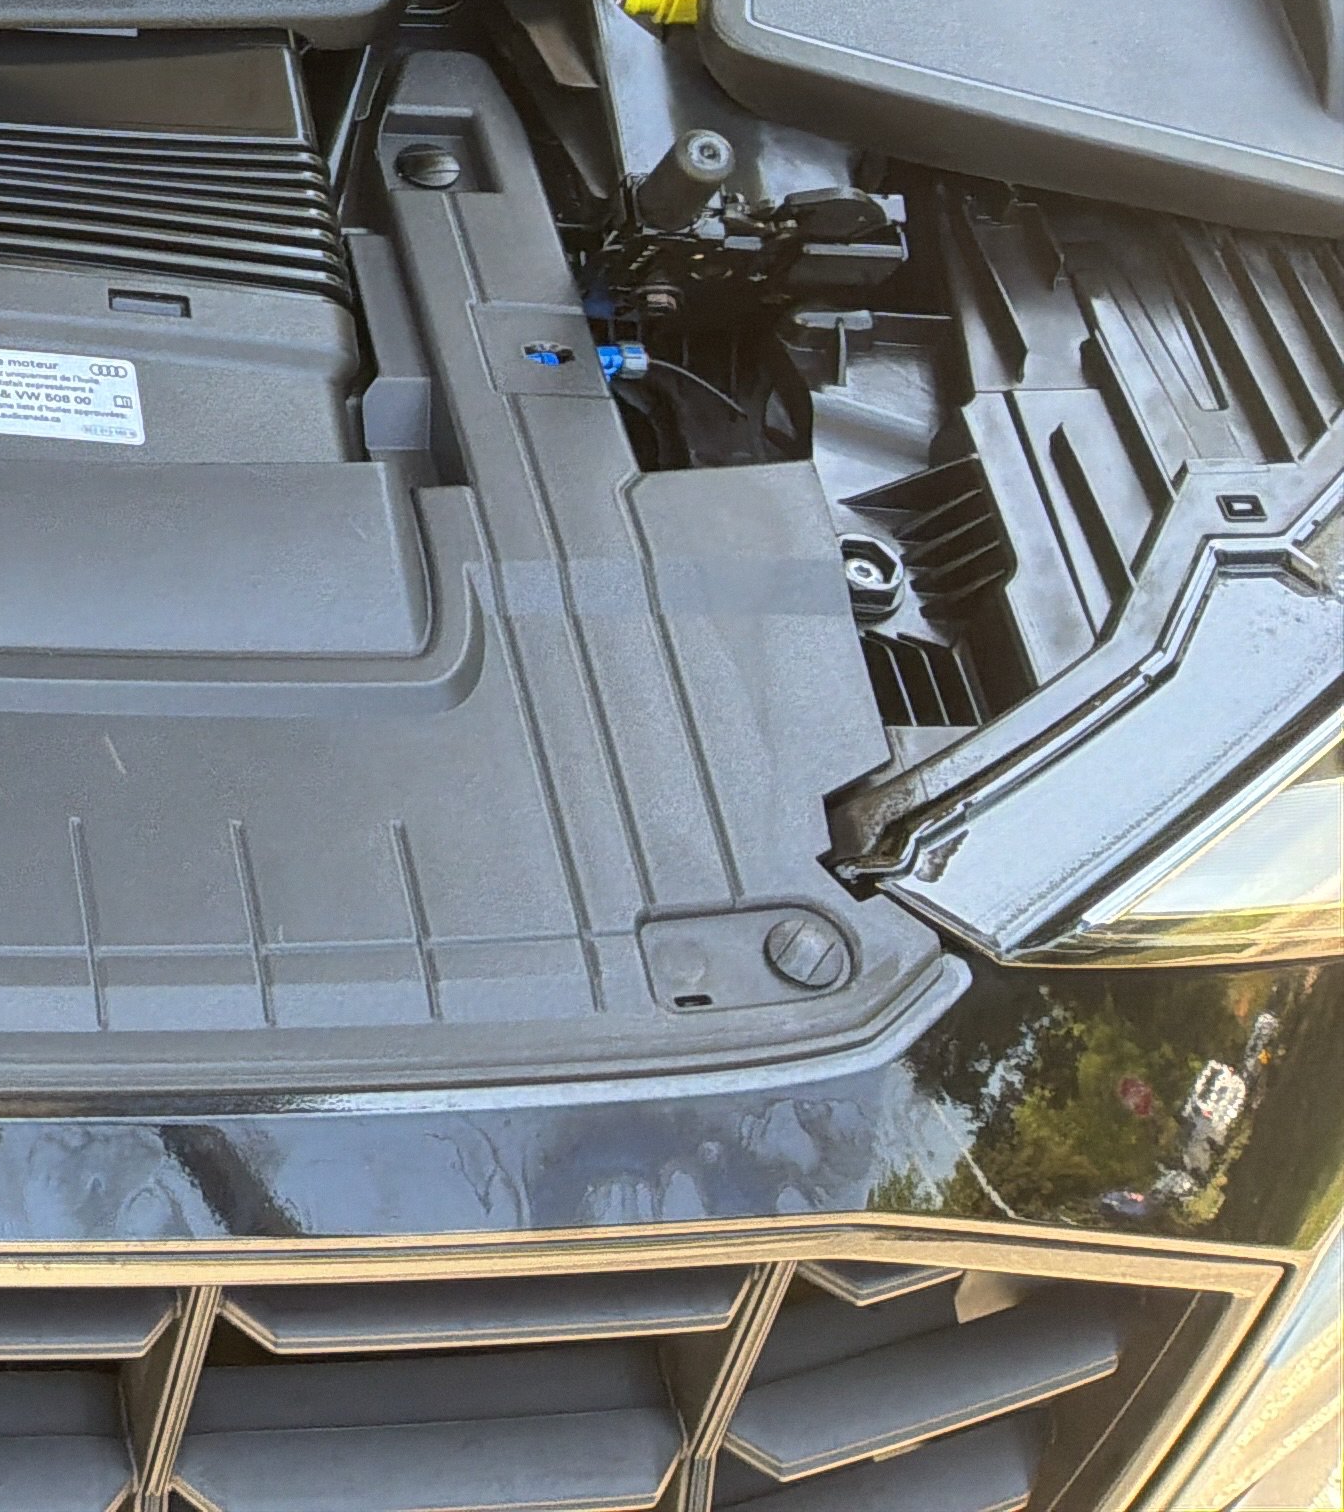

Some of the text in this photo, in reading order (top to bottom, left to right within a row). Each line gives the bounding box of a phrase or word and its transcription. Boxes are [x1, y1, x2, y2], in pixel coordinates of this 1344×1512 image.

[7, 359, 59, 370] moteur
[59, 373, 71, 383] de
[0, 388, 12, 399] &
[14, 389, 41, 401] VW
[45, 392, 71, 404] 508
[73, 395, 92, 406] 00
[16, 402, 35, 411] liste
